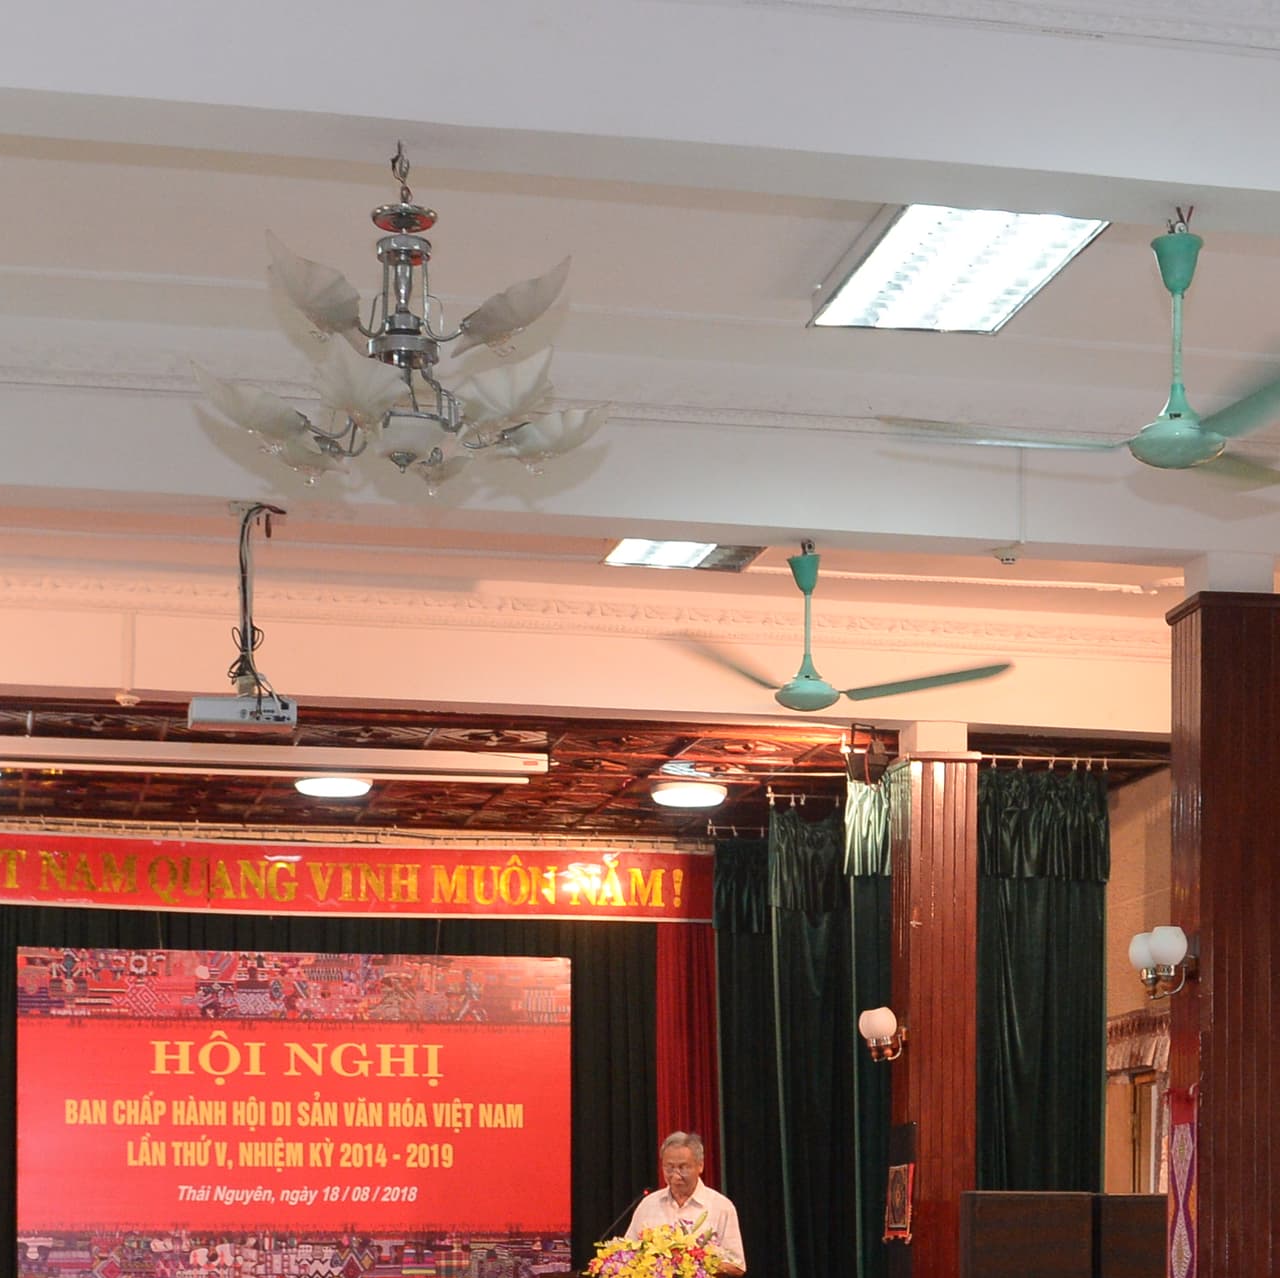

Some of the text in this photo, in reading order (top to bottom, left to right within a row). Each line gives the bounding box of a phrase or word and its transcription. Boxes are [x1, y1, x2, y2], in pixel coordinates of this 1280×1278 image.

[38, 849, 139, 894] NAM
[147, 852, 299, 904] QUANG
[306, 862, 422, 903] VINH
[431, 854, 557, 906] MUÔN
[150, 1030, 444, 1087] HỘI NGHỊ
[65, 1091, 524, 1134] BAN CHẤP HÀNH HỘI DI SẢN VĂN HÓA VIỆT NAM
[127, 1131, 168, 1168] LẦN
[172, 1138, 213, 1168] THỨ
[215, 1142, 235, 1171] V,
[239, 1139, 305, 1173] NHIỆM
[309, 1137, 335, 1168] KỲ
[340, 1143, 388, 1169] 2014
[406, 1143, 454, 1169] 2019
[177, 1184, 211, 1202] Thái
[213, 1185, 276, 1206] Nguyên,
[280, 1187, 319, 1206] ngày
